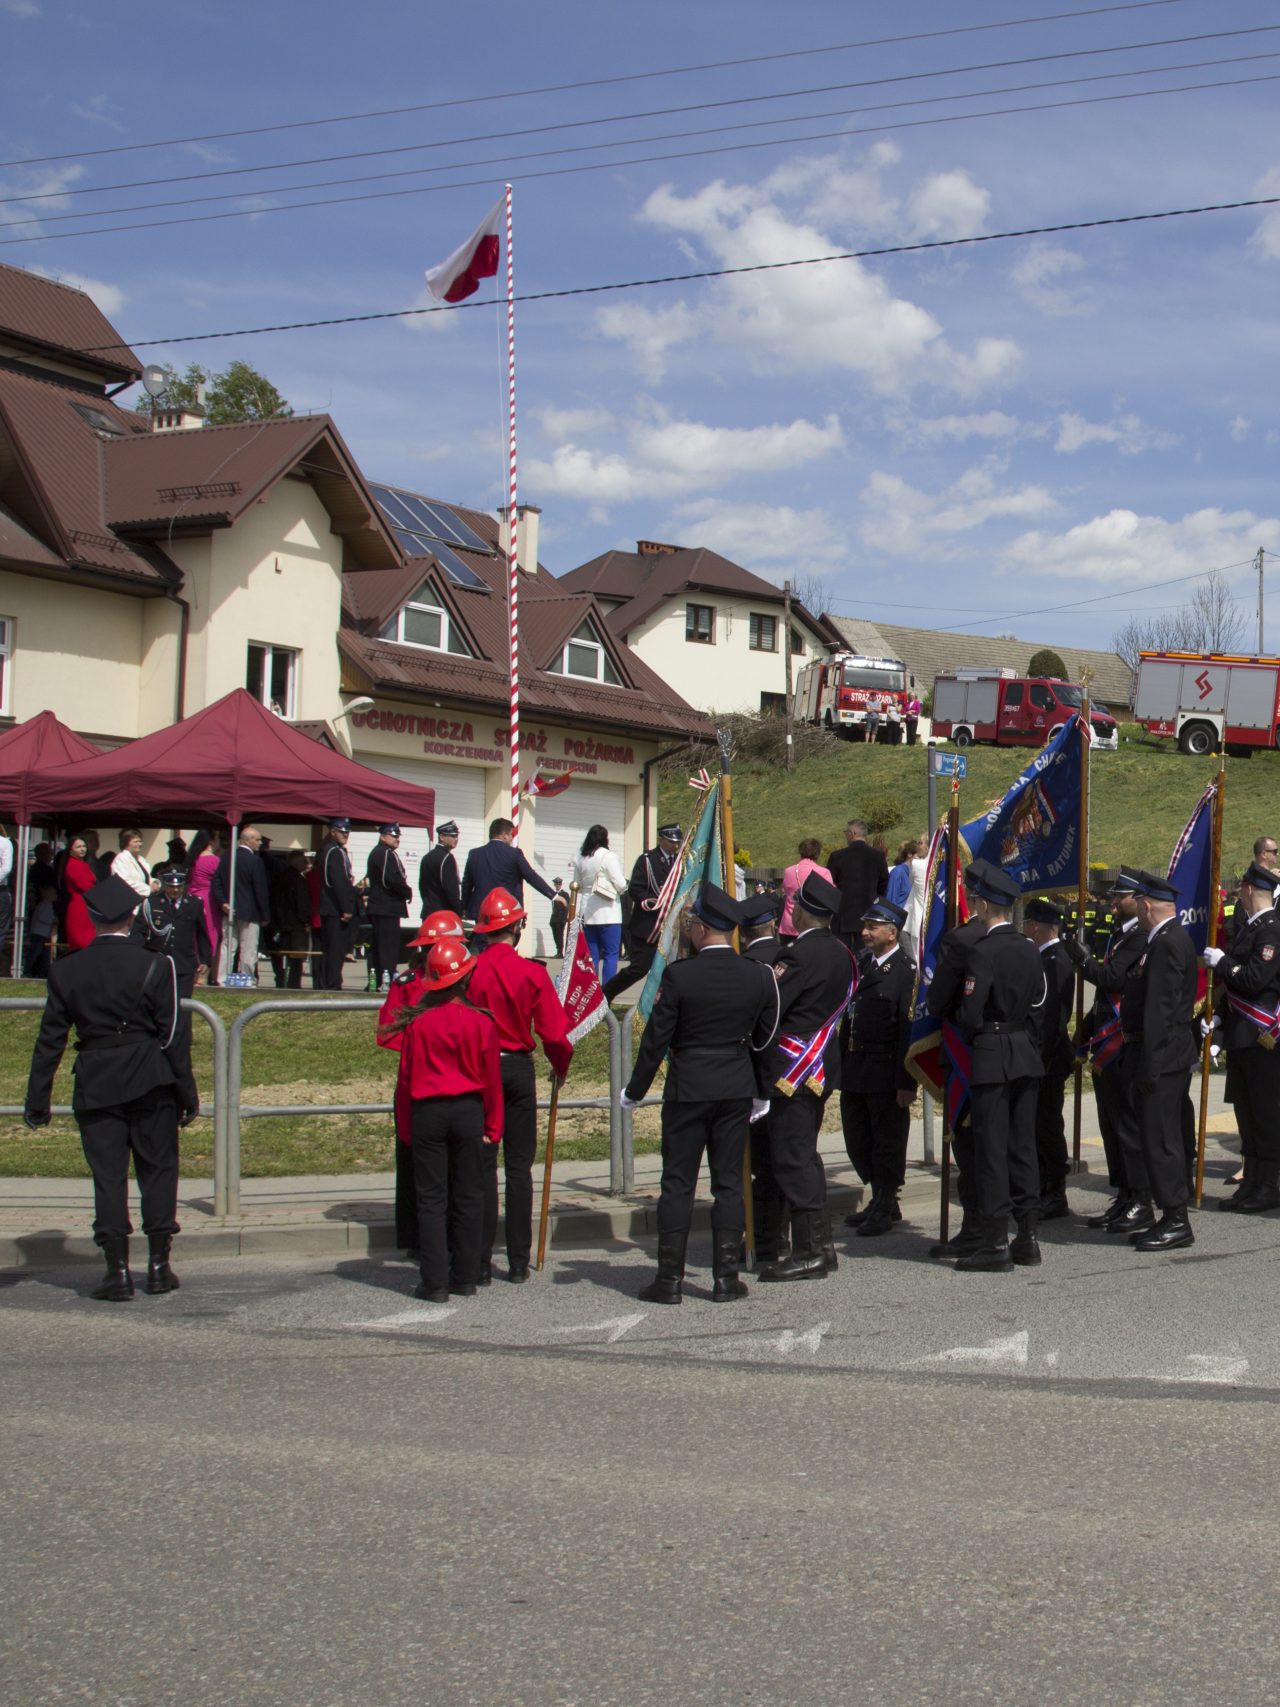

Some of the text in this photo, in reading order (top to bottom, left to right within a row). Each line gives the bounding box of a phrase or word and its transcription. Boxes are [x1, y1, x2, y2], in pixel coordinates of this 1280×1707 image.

[351, 709, 634, 765] OCHOTNICZA STRAŻ POŻARNA
[423, 740, 599, 775] KORZENNA CENTRUM
[1020, 823, 1077, 884] NA RATUNEK
[567, 985, 582, 1006] MDP
[572, 980, 600, 1022] JASIENNA
